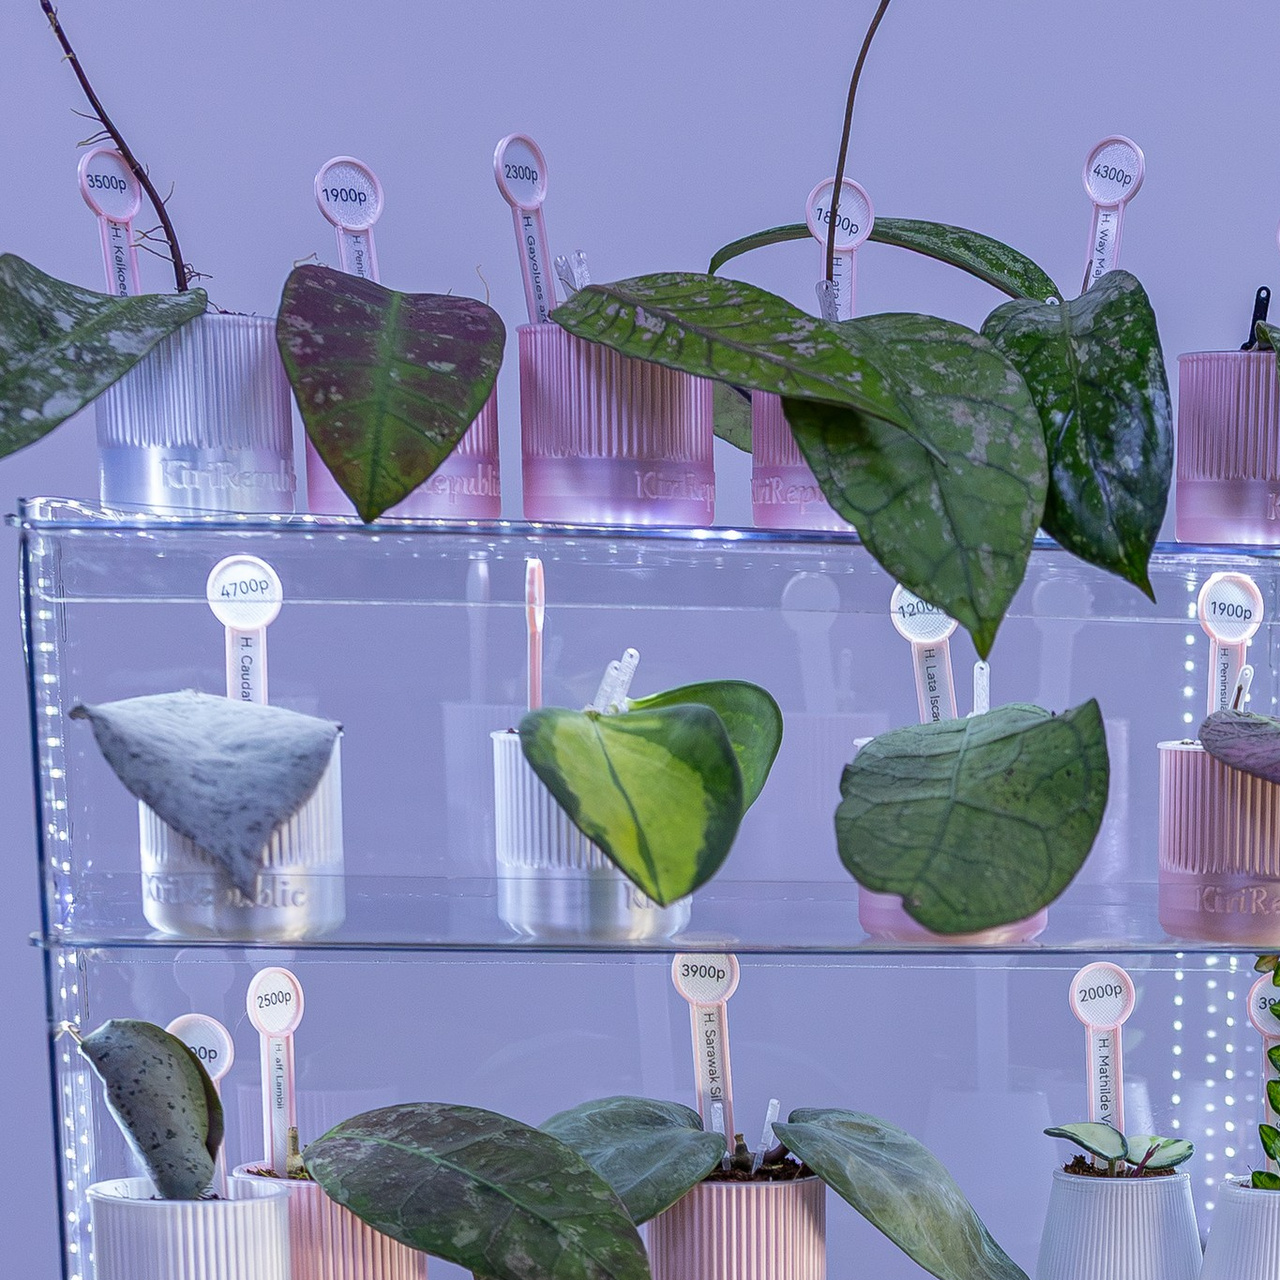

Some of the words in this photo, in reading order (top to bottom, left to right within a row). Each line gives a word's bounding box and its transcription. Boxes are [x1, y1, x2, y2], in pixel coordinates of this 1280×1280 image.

[1096, 229, 1109, 254] Way
[705, 1030, 719, 1083] Sarawak
[1100, 1055, 1111, 1110] Mathilde
